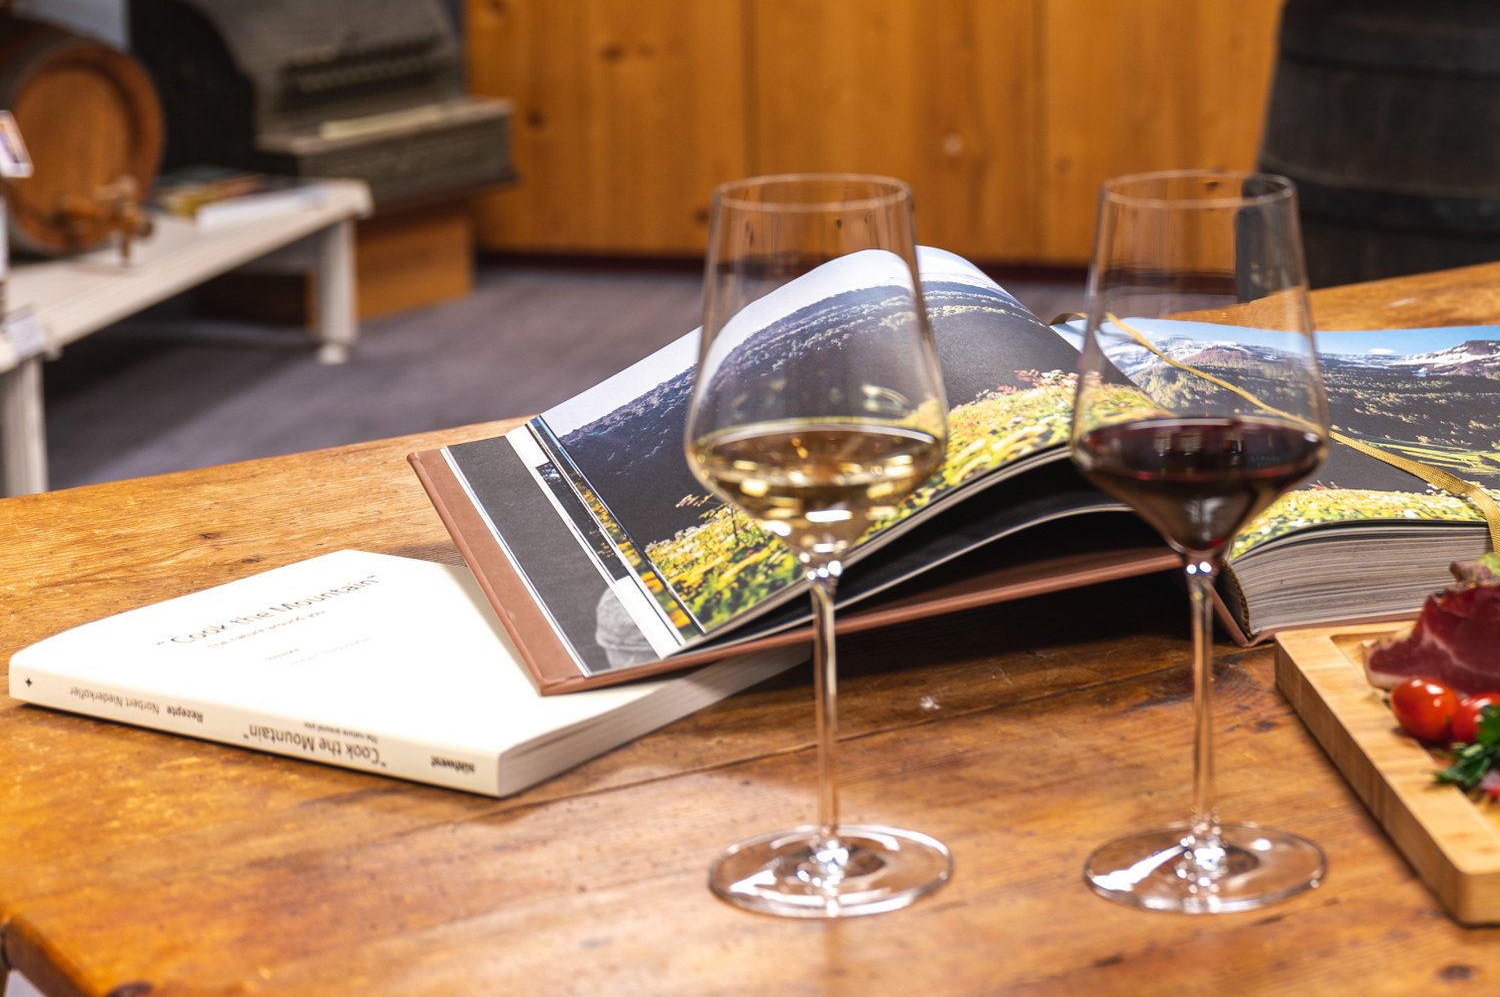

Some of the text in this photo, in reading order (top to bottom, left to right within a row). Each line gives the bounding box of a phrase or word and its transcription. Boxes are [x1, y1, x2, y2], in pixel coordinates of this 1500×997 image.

[229, 611, 275, 624] the
[125, 697, 160, 714] Norbert
[166, 705, 203, 723] Rezepte
[319, 737, 341, 755] the
